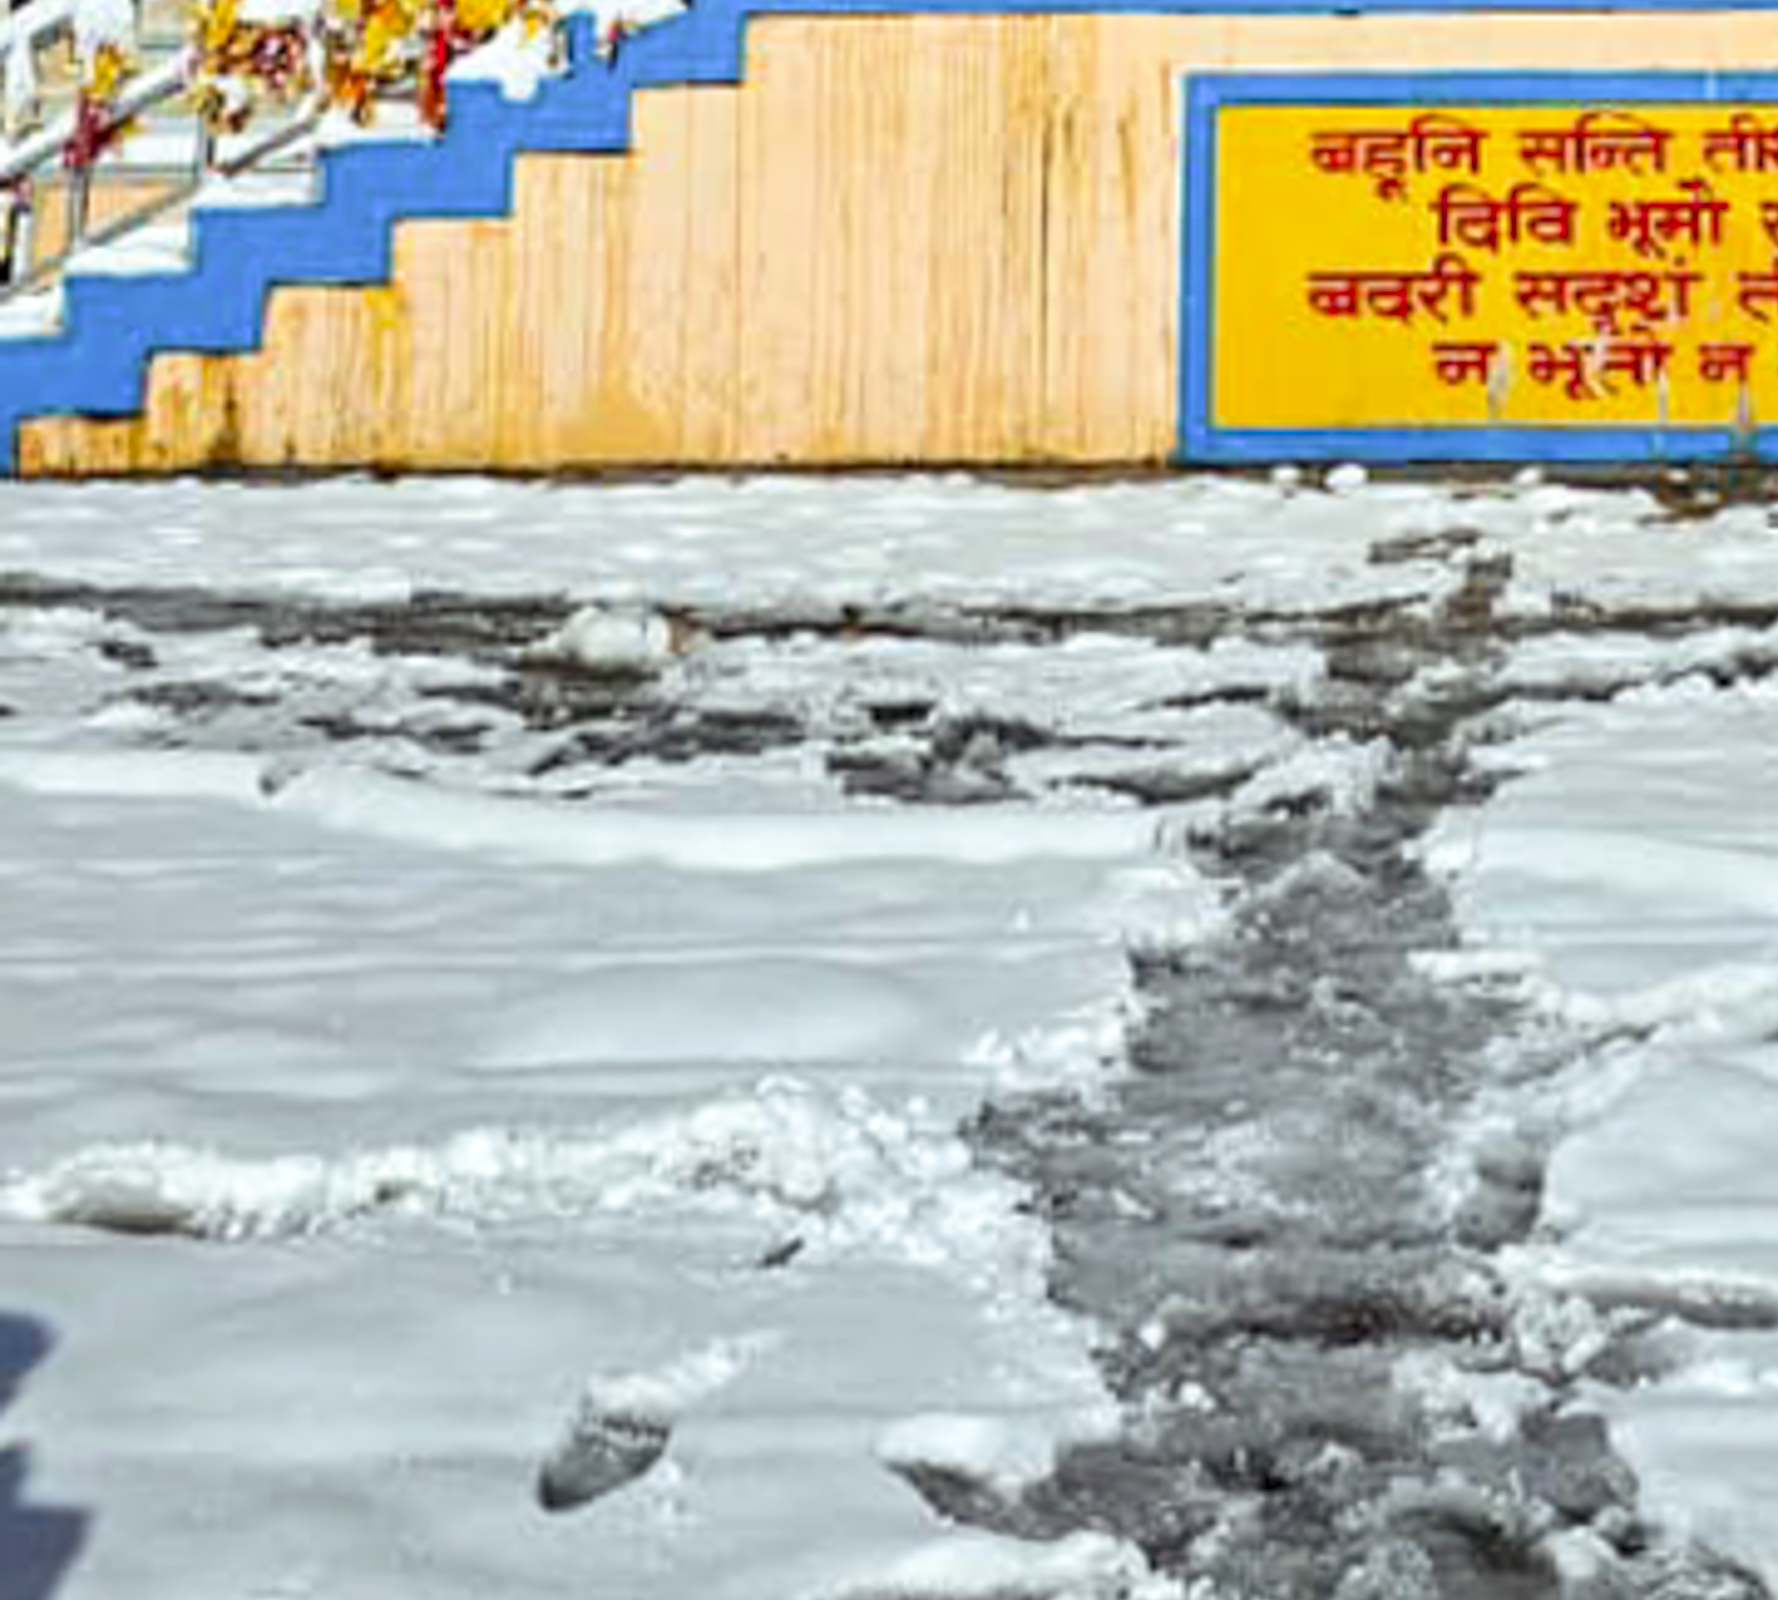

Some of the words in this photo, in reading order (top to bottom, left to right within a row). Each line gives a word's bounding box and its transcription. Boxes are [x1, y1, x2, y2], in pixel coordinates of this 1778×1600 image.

[1309, 113, 1490, 202] बहूनि
[1516, 111, 1673, 176] सन्ति
[1428, 183, 1579, 255] दिवि
[1307, 252, 1481, 326] बदरी
[1514, 254, 1705, 336] सदृशं
[1431, 342, 1498, 385] न
[1698, 343, 1754, 383] न
